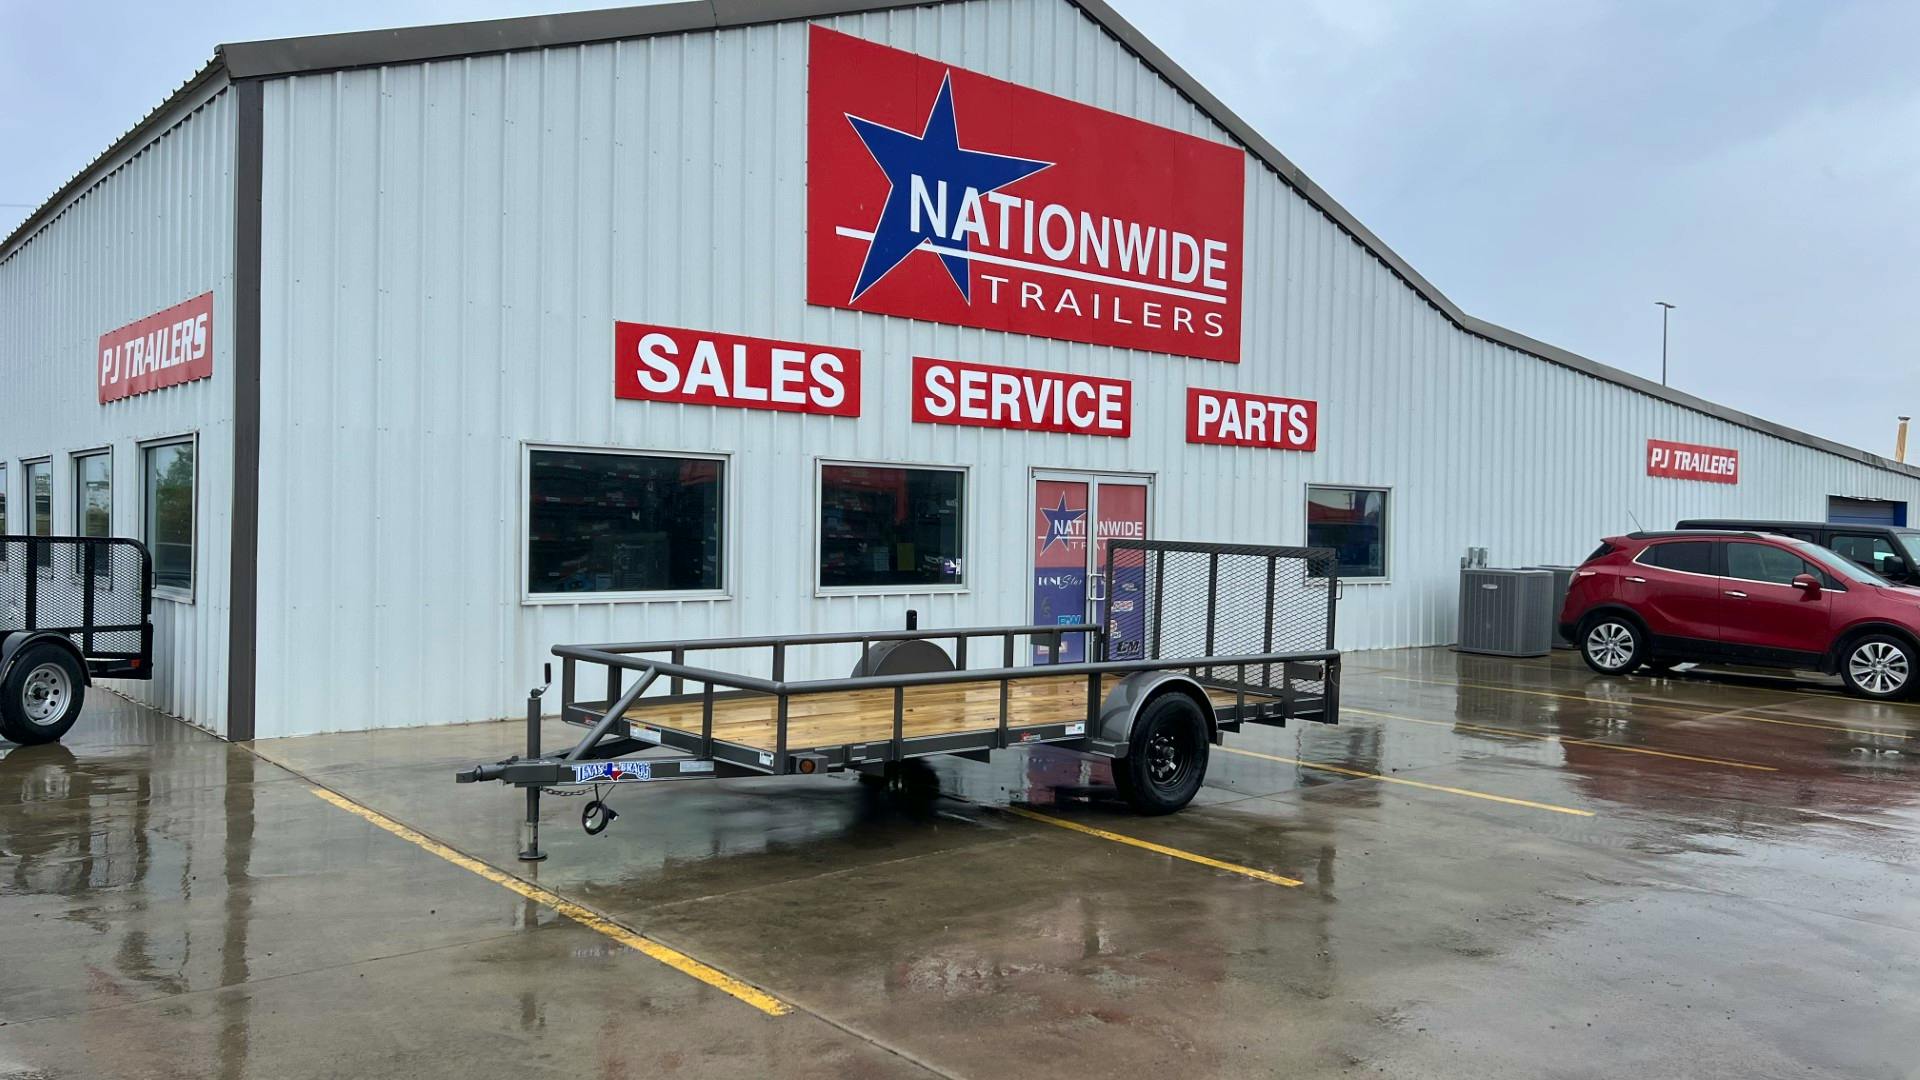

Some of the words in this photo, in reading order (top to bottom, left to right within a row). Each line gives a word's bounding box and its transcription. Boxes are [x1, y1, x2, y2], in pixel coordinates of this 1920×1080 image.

[910, 174, 1227, 290] NATIONWIDE
[980, 274, 1224, 338] TRAILERS
[101, 344, 121, 387] PJ
[124, 312, 208, 380] TRAILERS
[636, 333, 845, 408] SALES
[923, 365, 1124, 430] SERVICE
[1197, 396, 1308, 446] PARTS
[1650, 447, 1670, 469] PJ
[1673, 449, 1736, 475] TRAILERS
[1054, 519, 1143, 536] NATINWIDE
[573, 763, 605, 783] TEXAS
